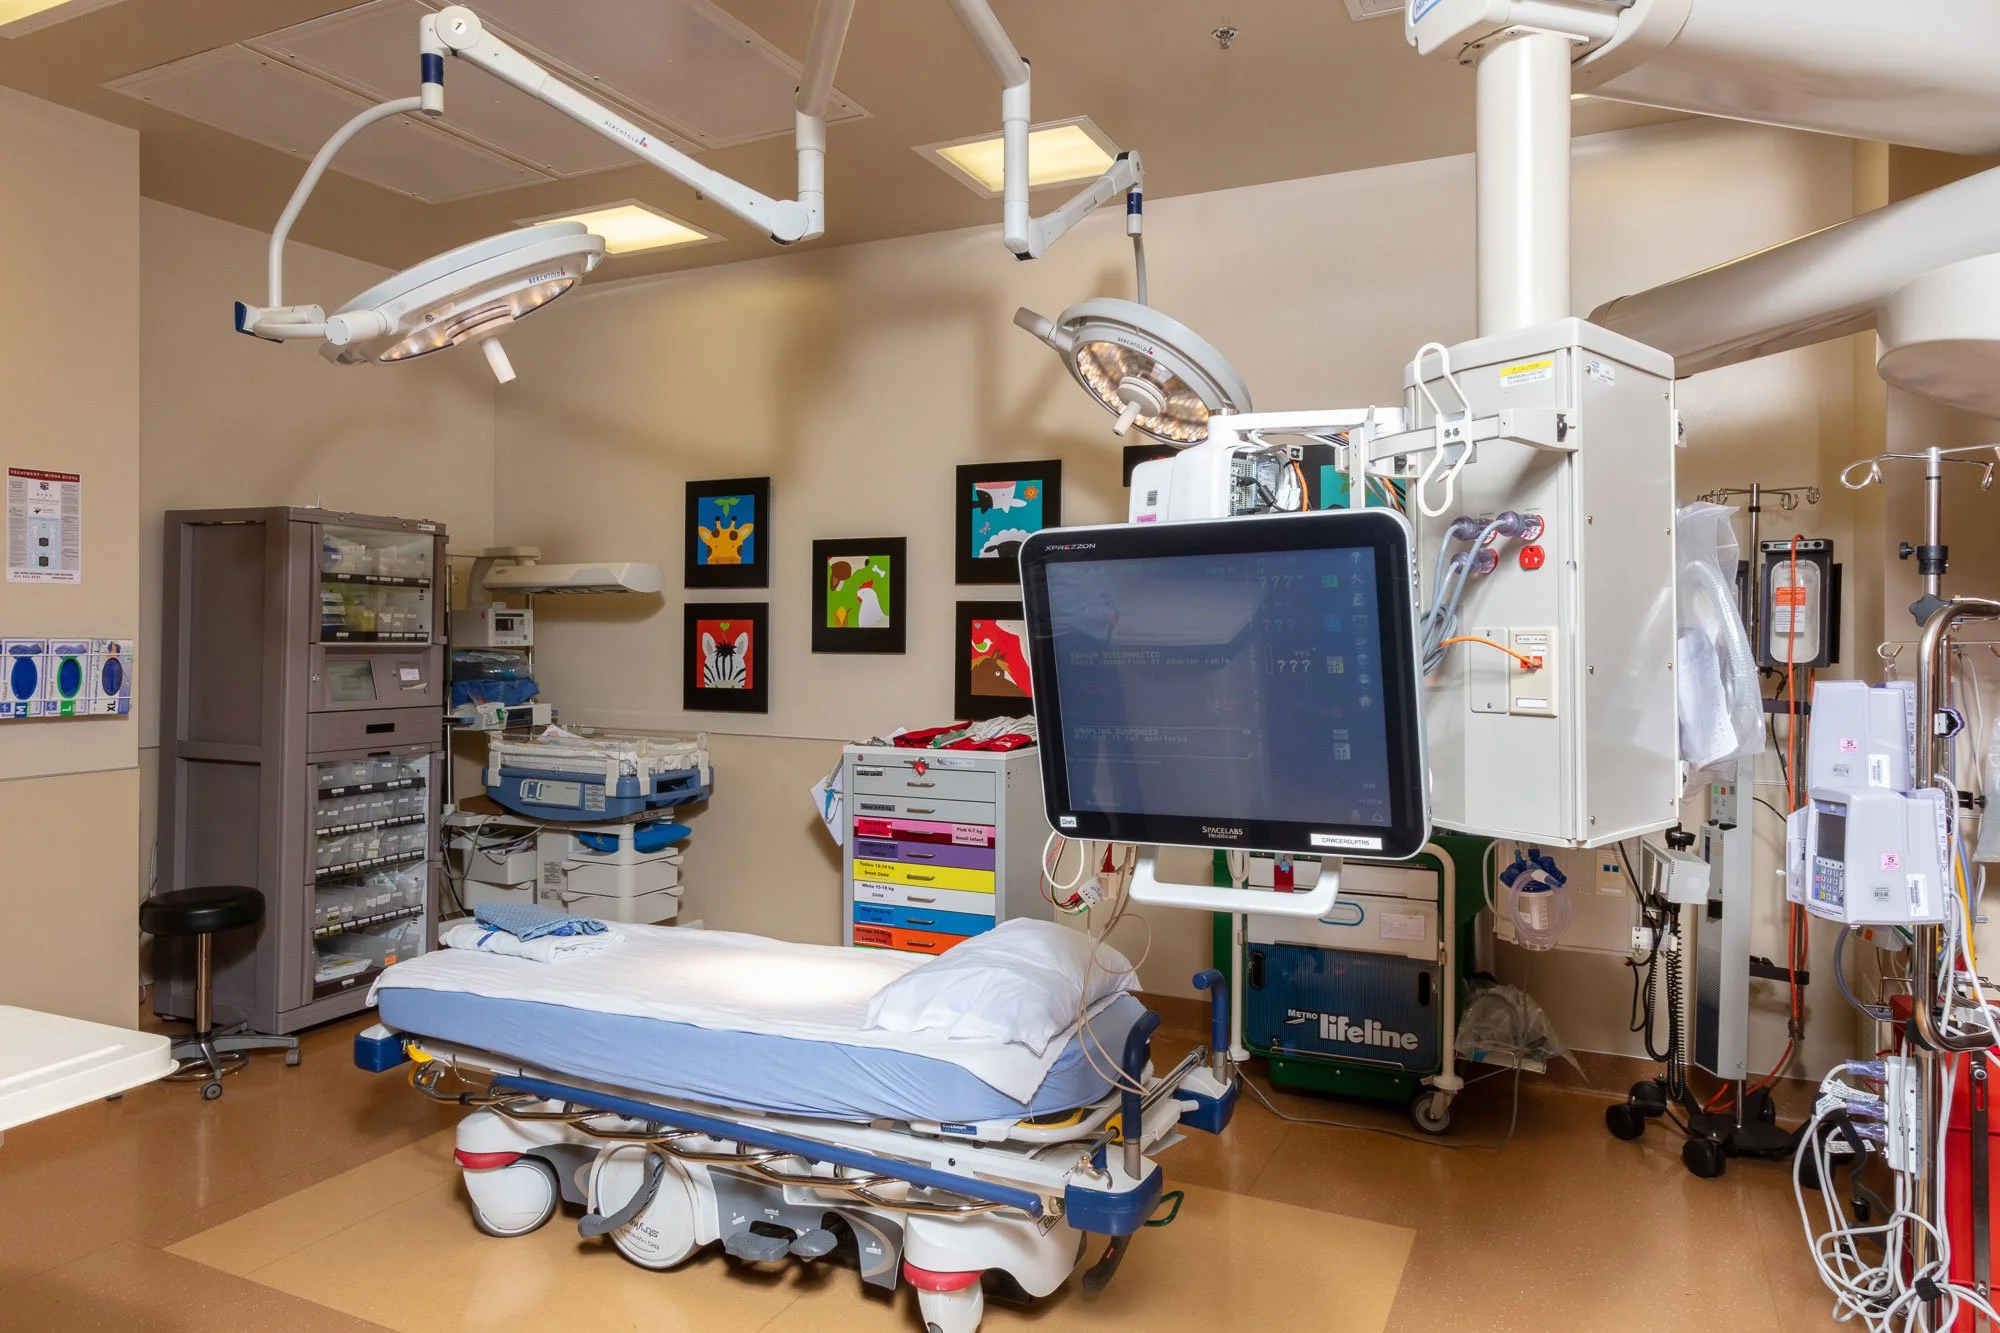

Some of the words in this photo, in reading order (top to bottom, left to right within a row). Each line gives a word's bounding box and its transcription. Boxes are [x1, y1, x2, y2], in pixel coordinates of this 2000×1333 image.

[604, 120, 640, 143] BERCHTOLD
[528, 271, 561, 284] BERCHTOLD
[1117, 337, 1147, 352] BERCHTOLD
[1517, 363, 1540, 372] CAUTION
[10, 469, 40, 478] TREATMENT
[1045, 543, 1096, 551] XPREZZON
[15, 705, 26, 714] M
[106, 700, 116, 712] XL
[1202, 826, 1243, 836] SPACELABS
[856, 927, 873, 935] Orange
[1287, 1008, 1318, 1020] METRO
[1319, 1013, 1419, 1050] lifeline
